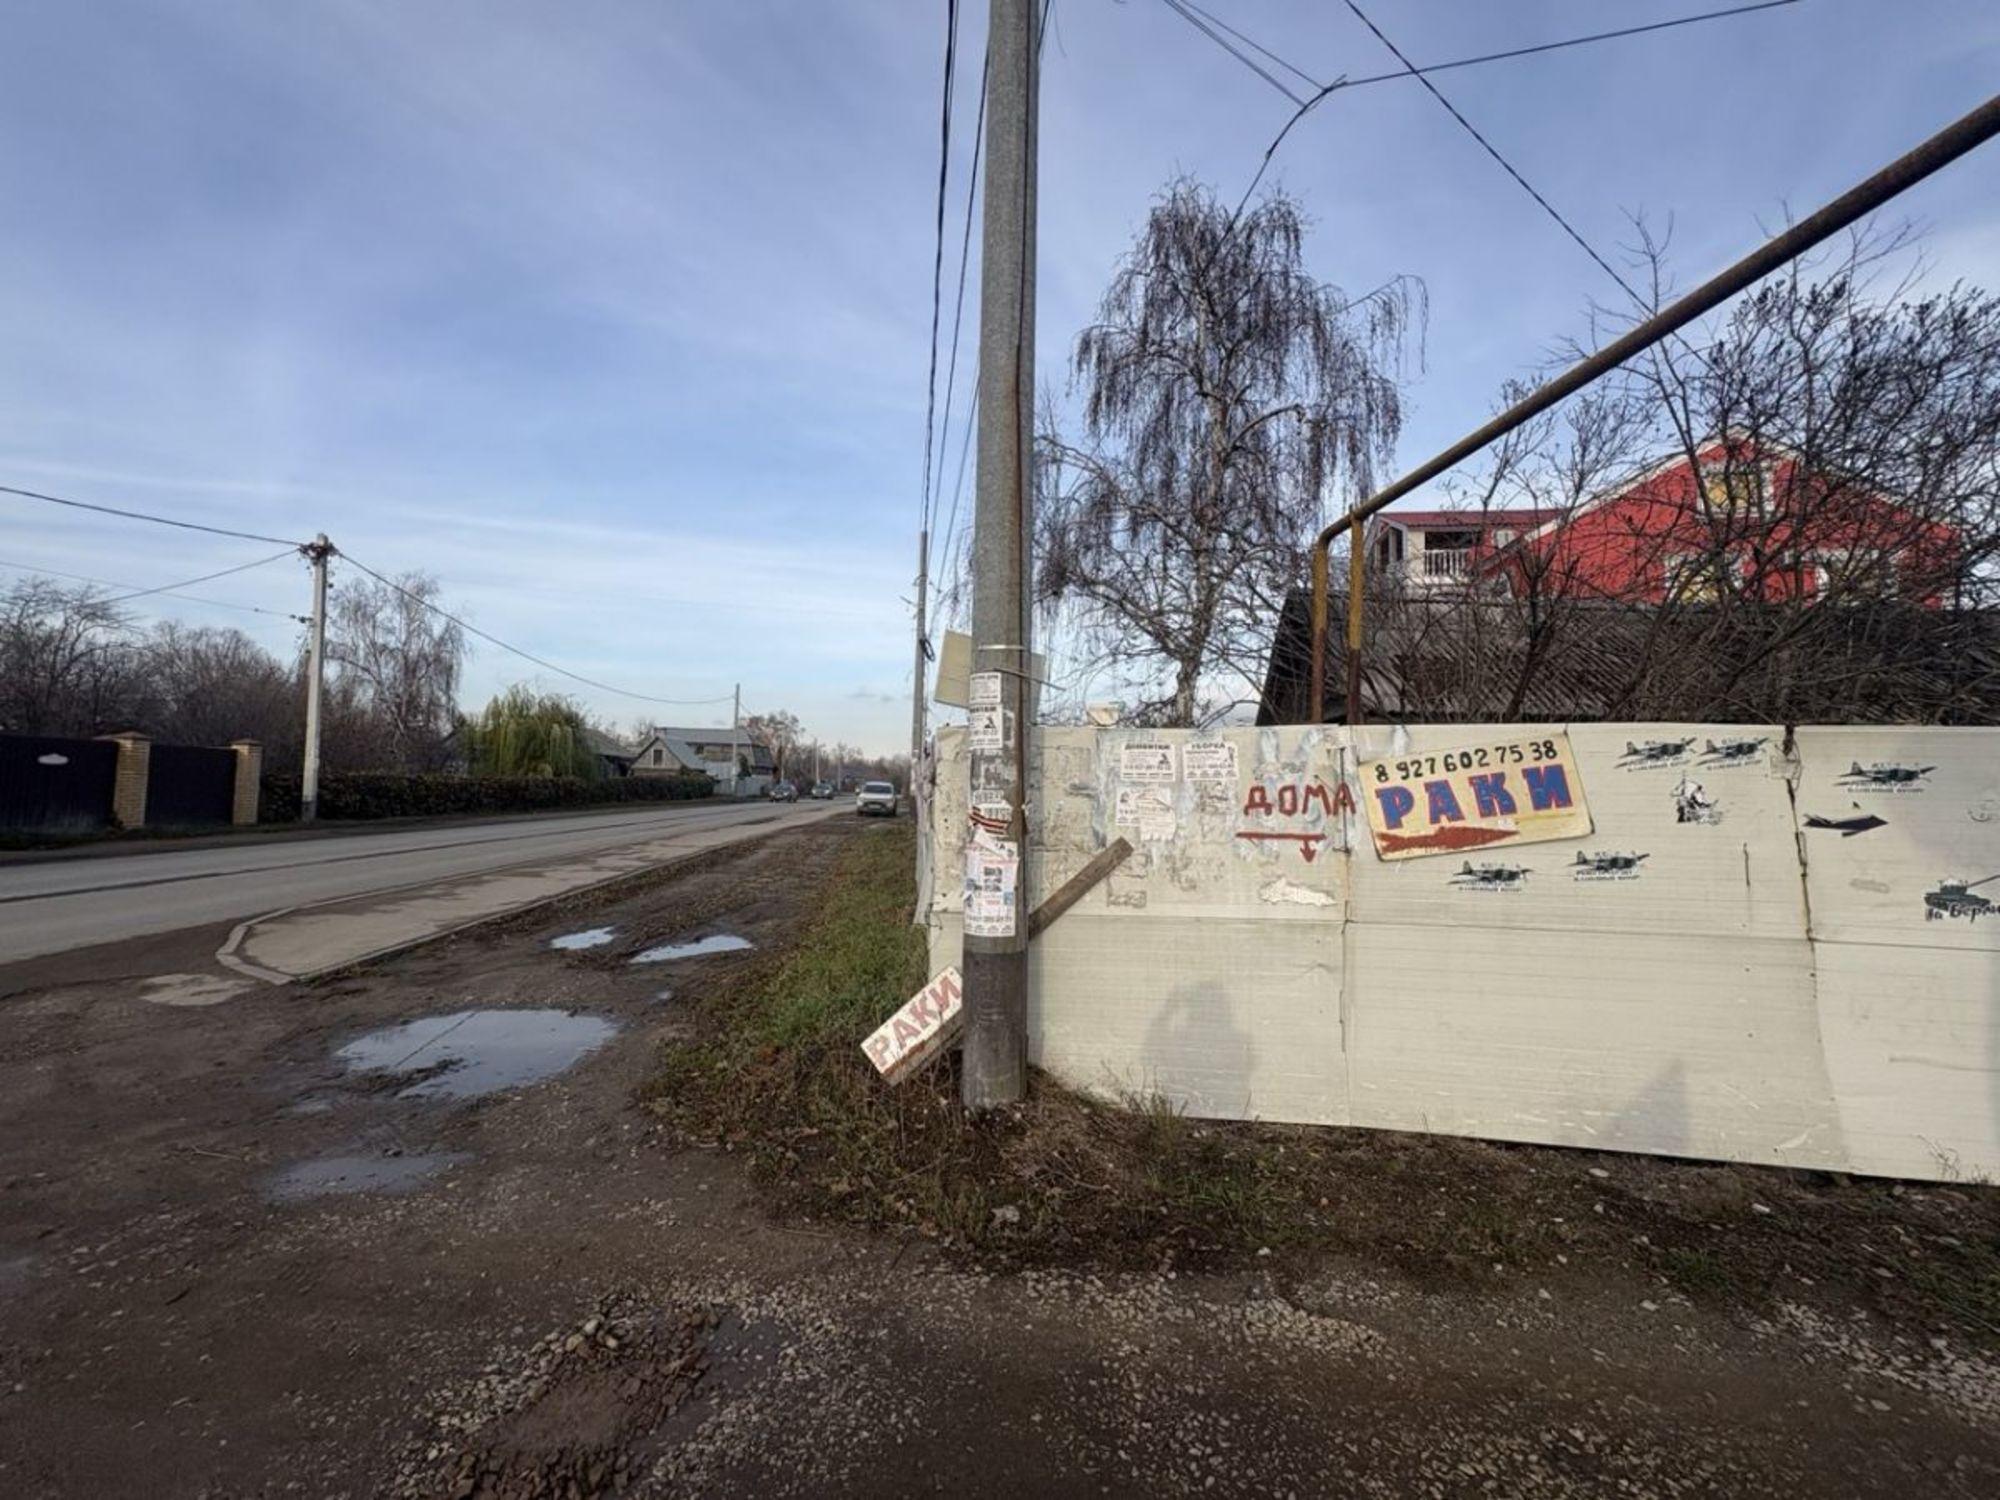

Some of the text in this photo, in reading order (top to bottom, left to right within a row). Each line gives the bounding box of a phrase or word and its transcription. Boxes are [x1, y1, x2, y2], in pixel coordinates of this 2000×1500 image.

[1375, 740, 1558, 782] 8 927 602 75 38
[1243, 781, 1357, 816] ДОМА
[1375, 764, 1573, 830] РАКИ
[865, 975, 961, 1067] РАКИ
